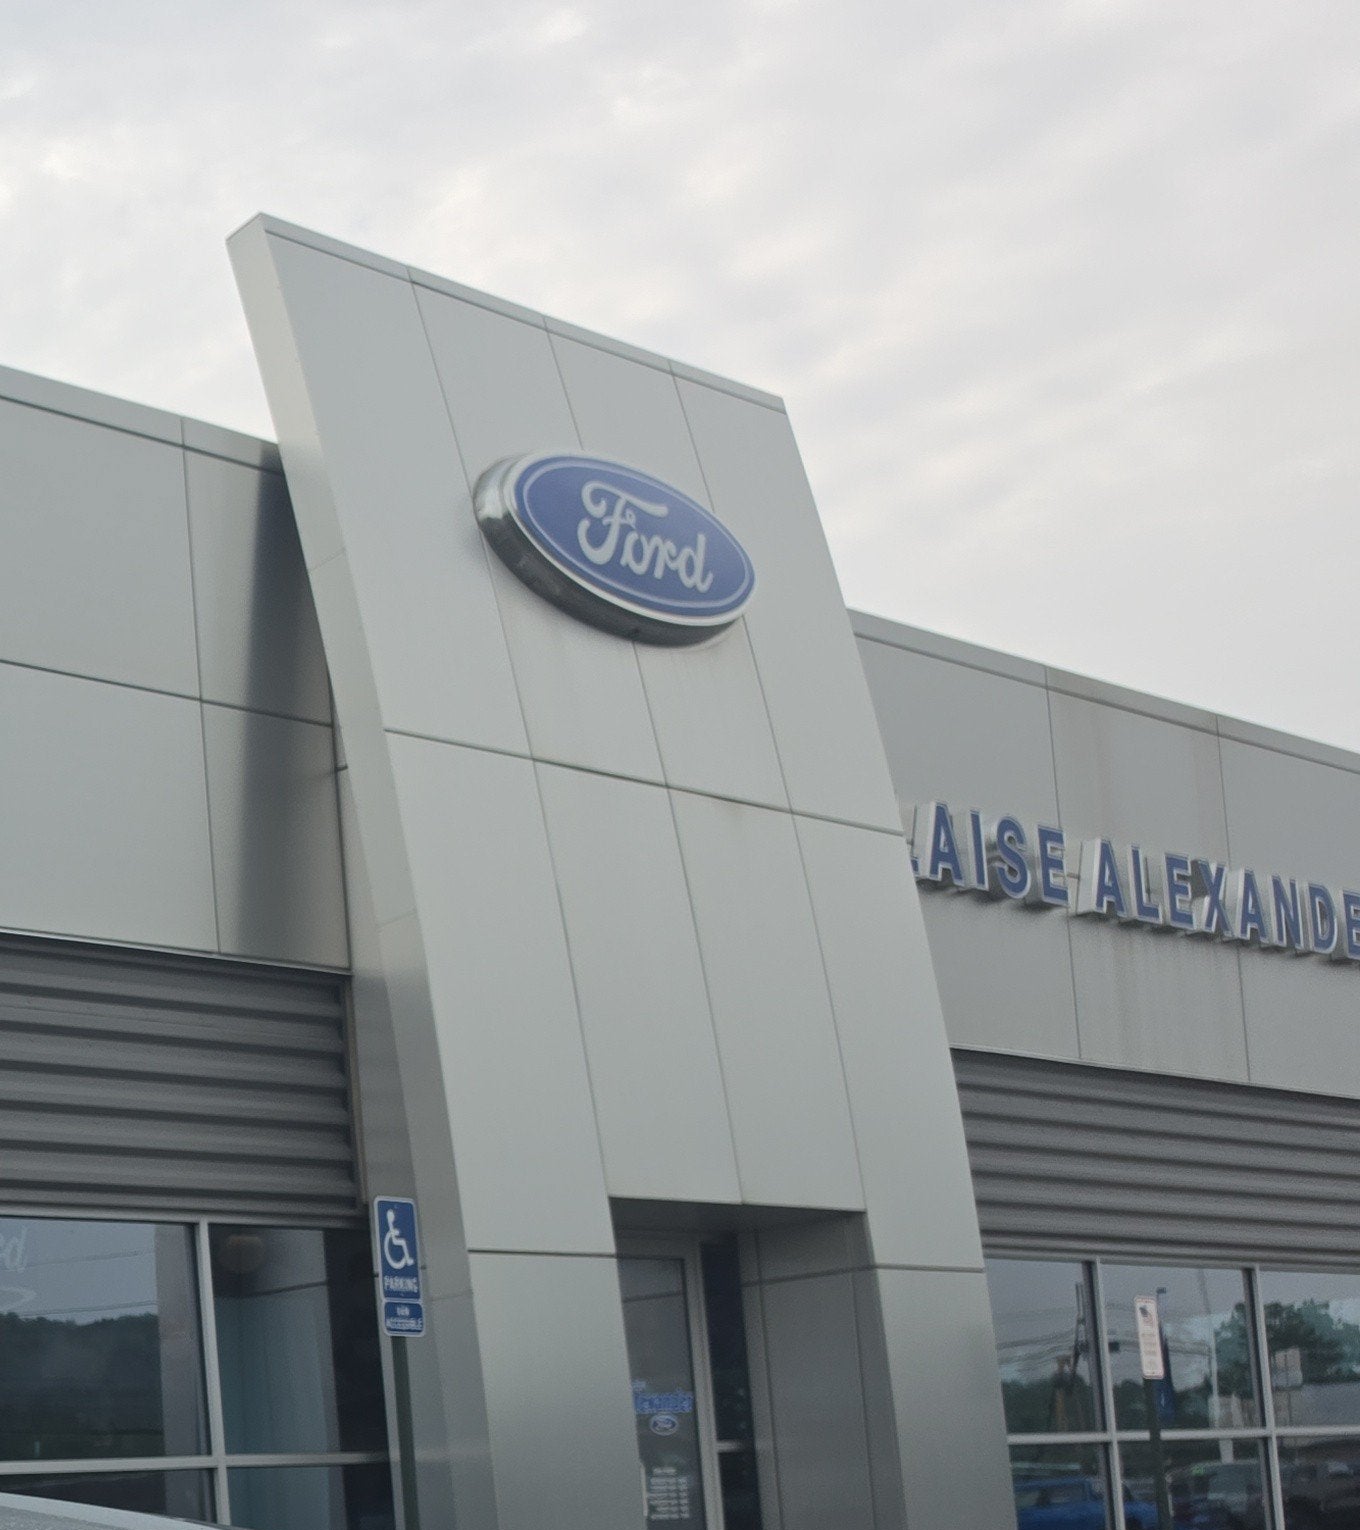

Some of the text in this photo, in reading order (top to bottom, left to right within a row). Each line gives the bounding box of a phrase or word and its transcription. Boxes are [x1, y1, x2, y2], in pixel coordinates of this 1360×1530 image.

[577, 480, 714, 594] Ford
[909, 801, 1069, 906] AISE
[383, 1275, 418, 1293] PARKING
